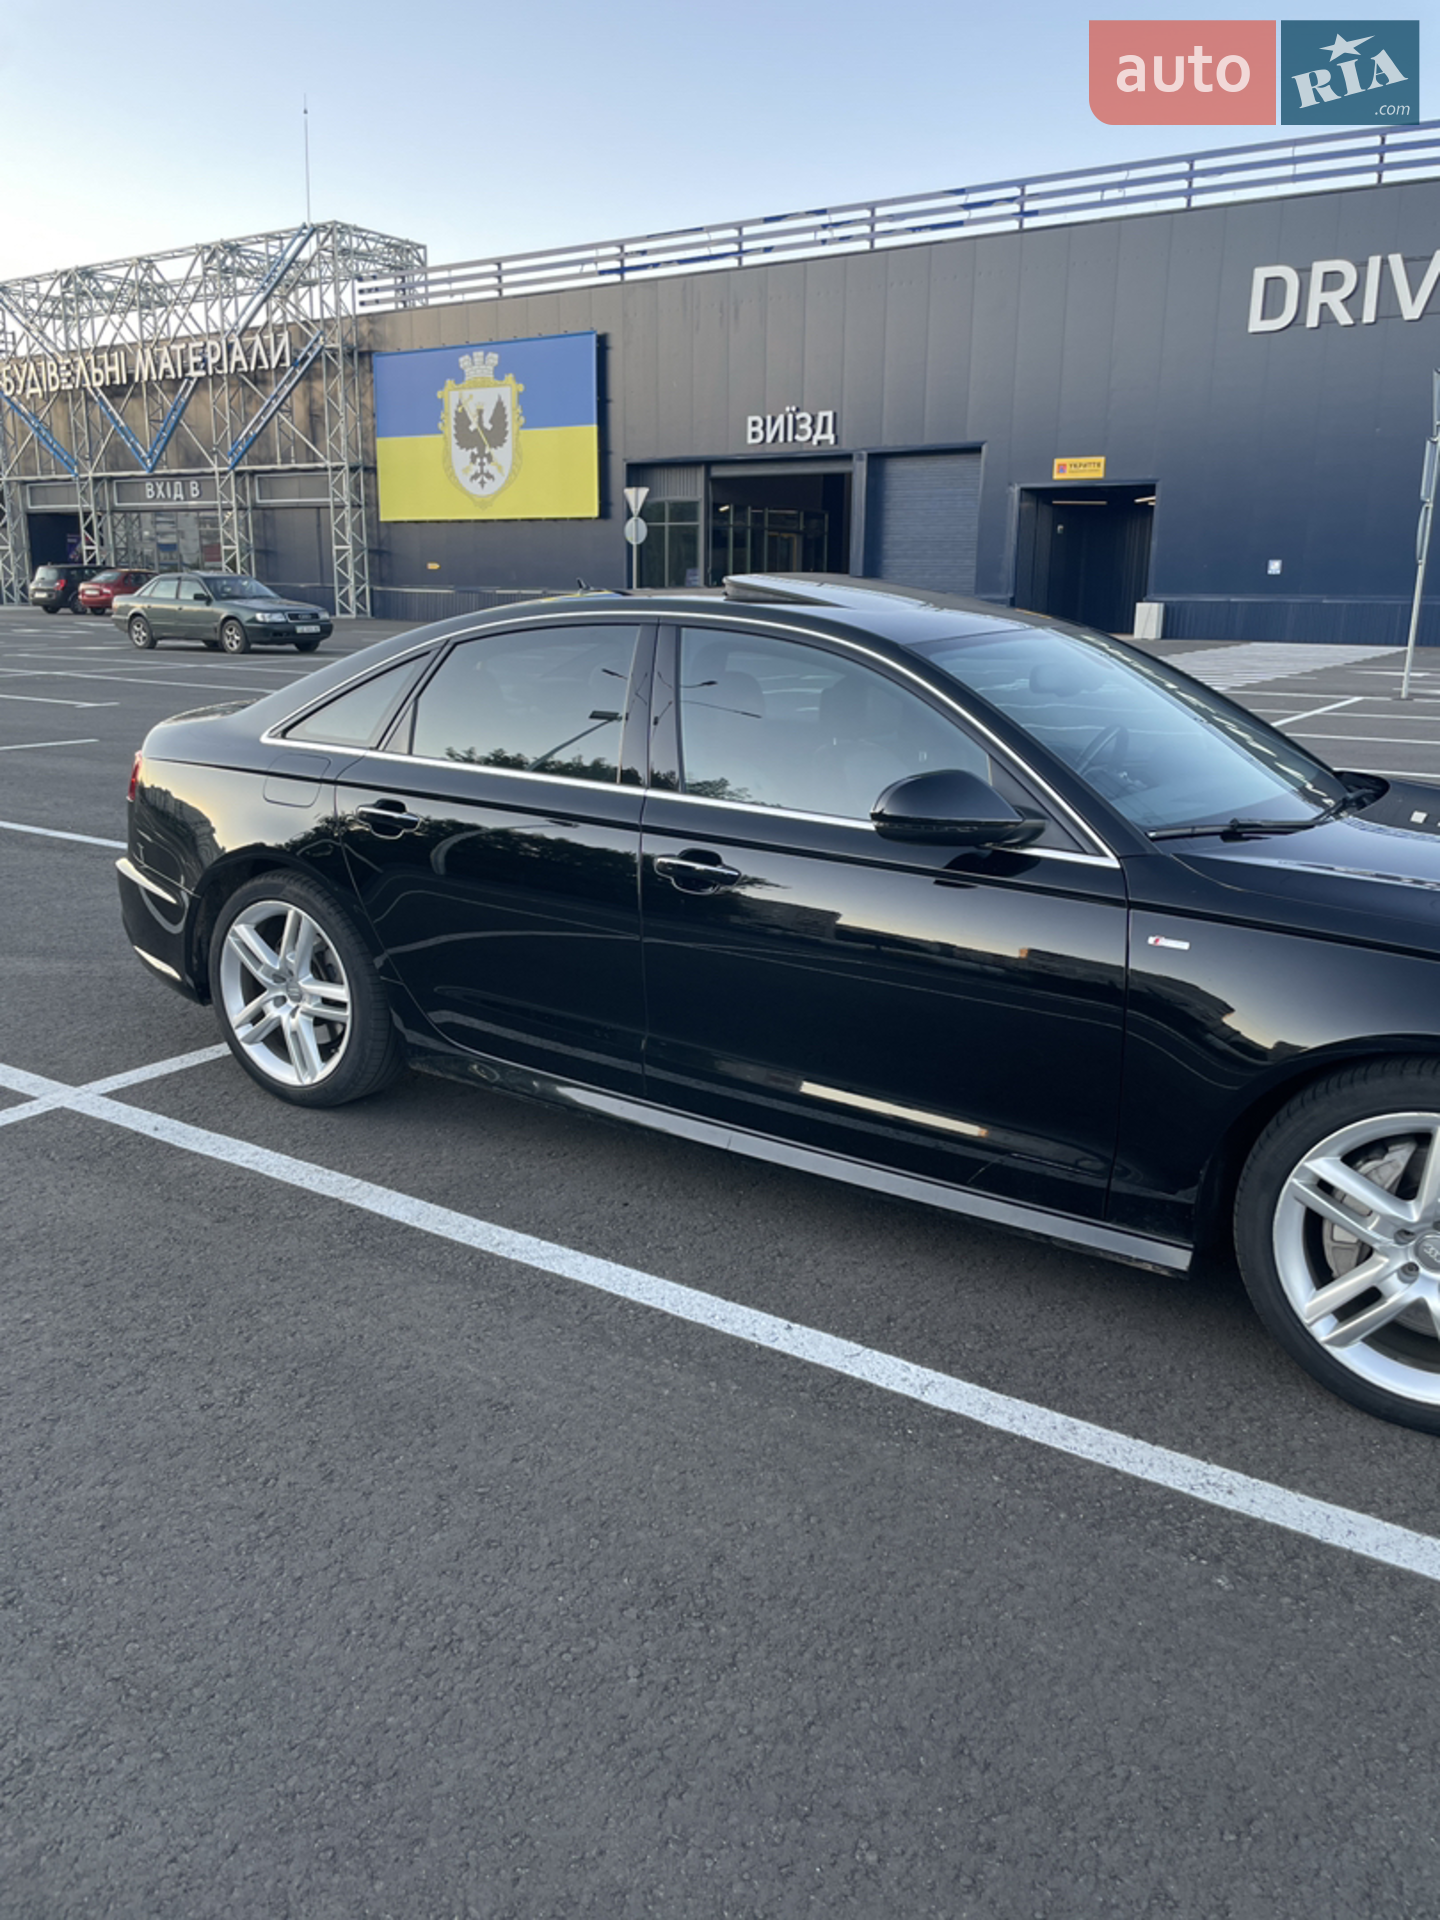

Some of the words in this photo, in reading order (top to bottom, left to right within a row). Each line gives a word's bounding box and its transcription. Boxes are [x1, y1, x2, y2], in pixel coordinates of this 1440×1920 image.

[1247, 249, 1440, 334] DRIV
[1, 350, 128, 400] БУДІВЕЛЬНІ
[134, 330, 292, 383] МАТЕРІАЛИ
[746, 405, 836, 446] ВИЇЗД
[145, 481, 184, 501] ВХІД
